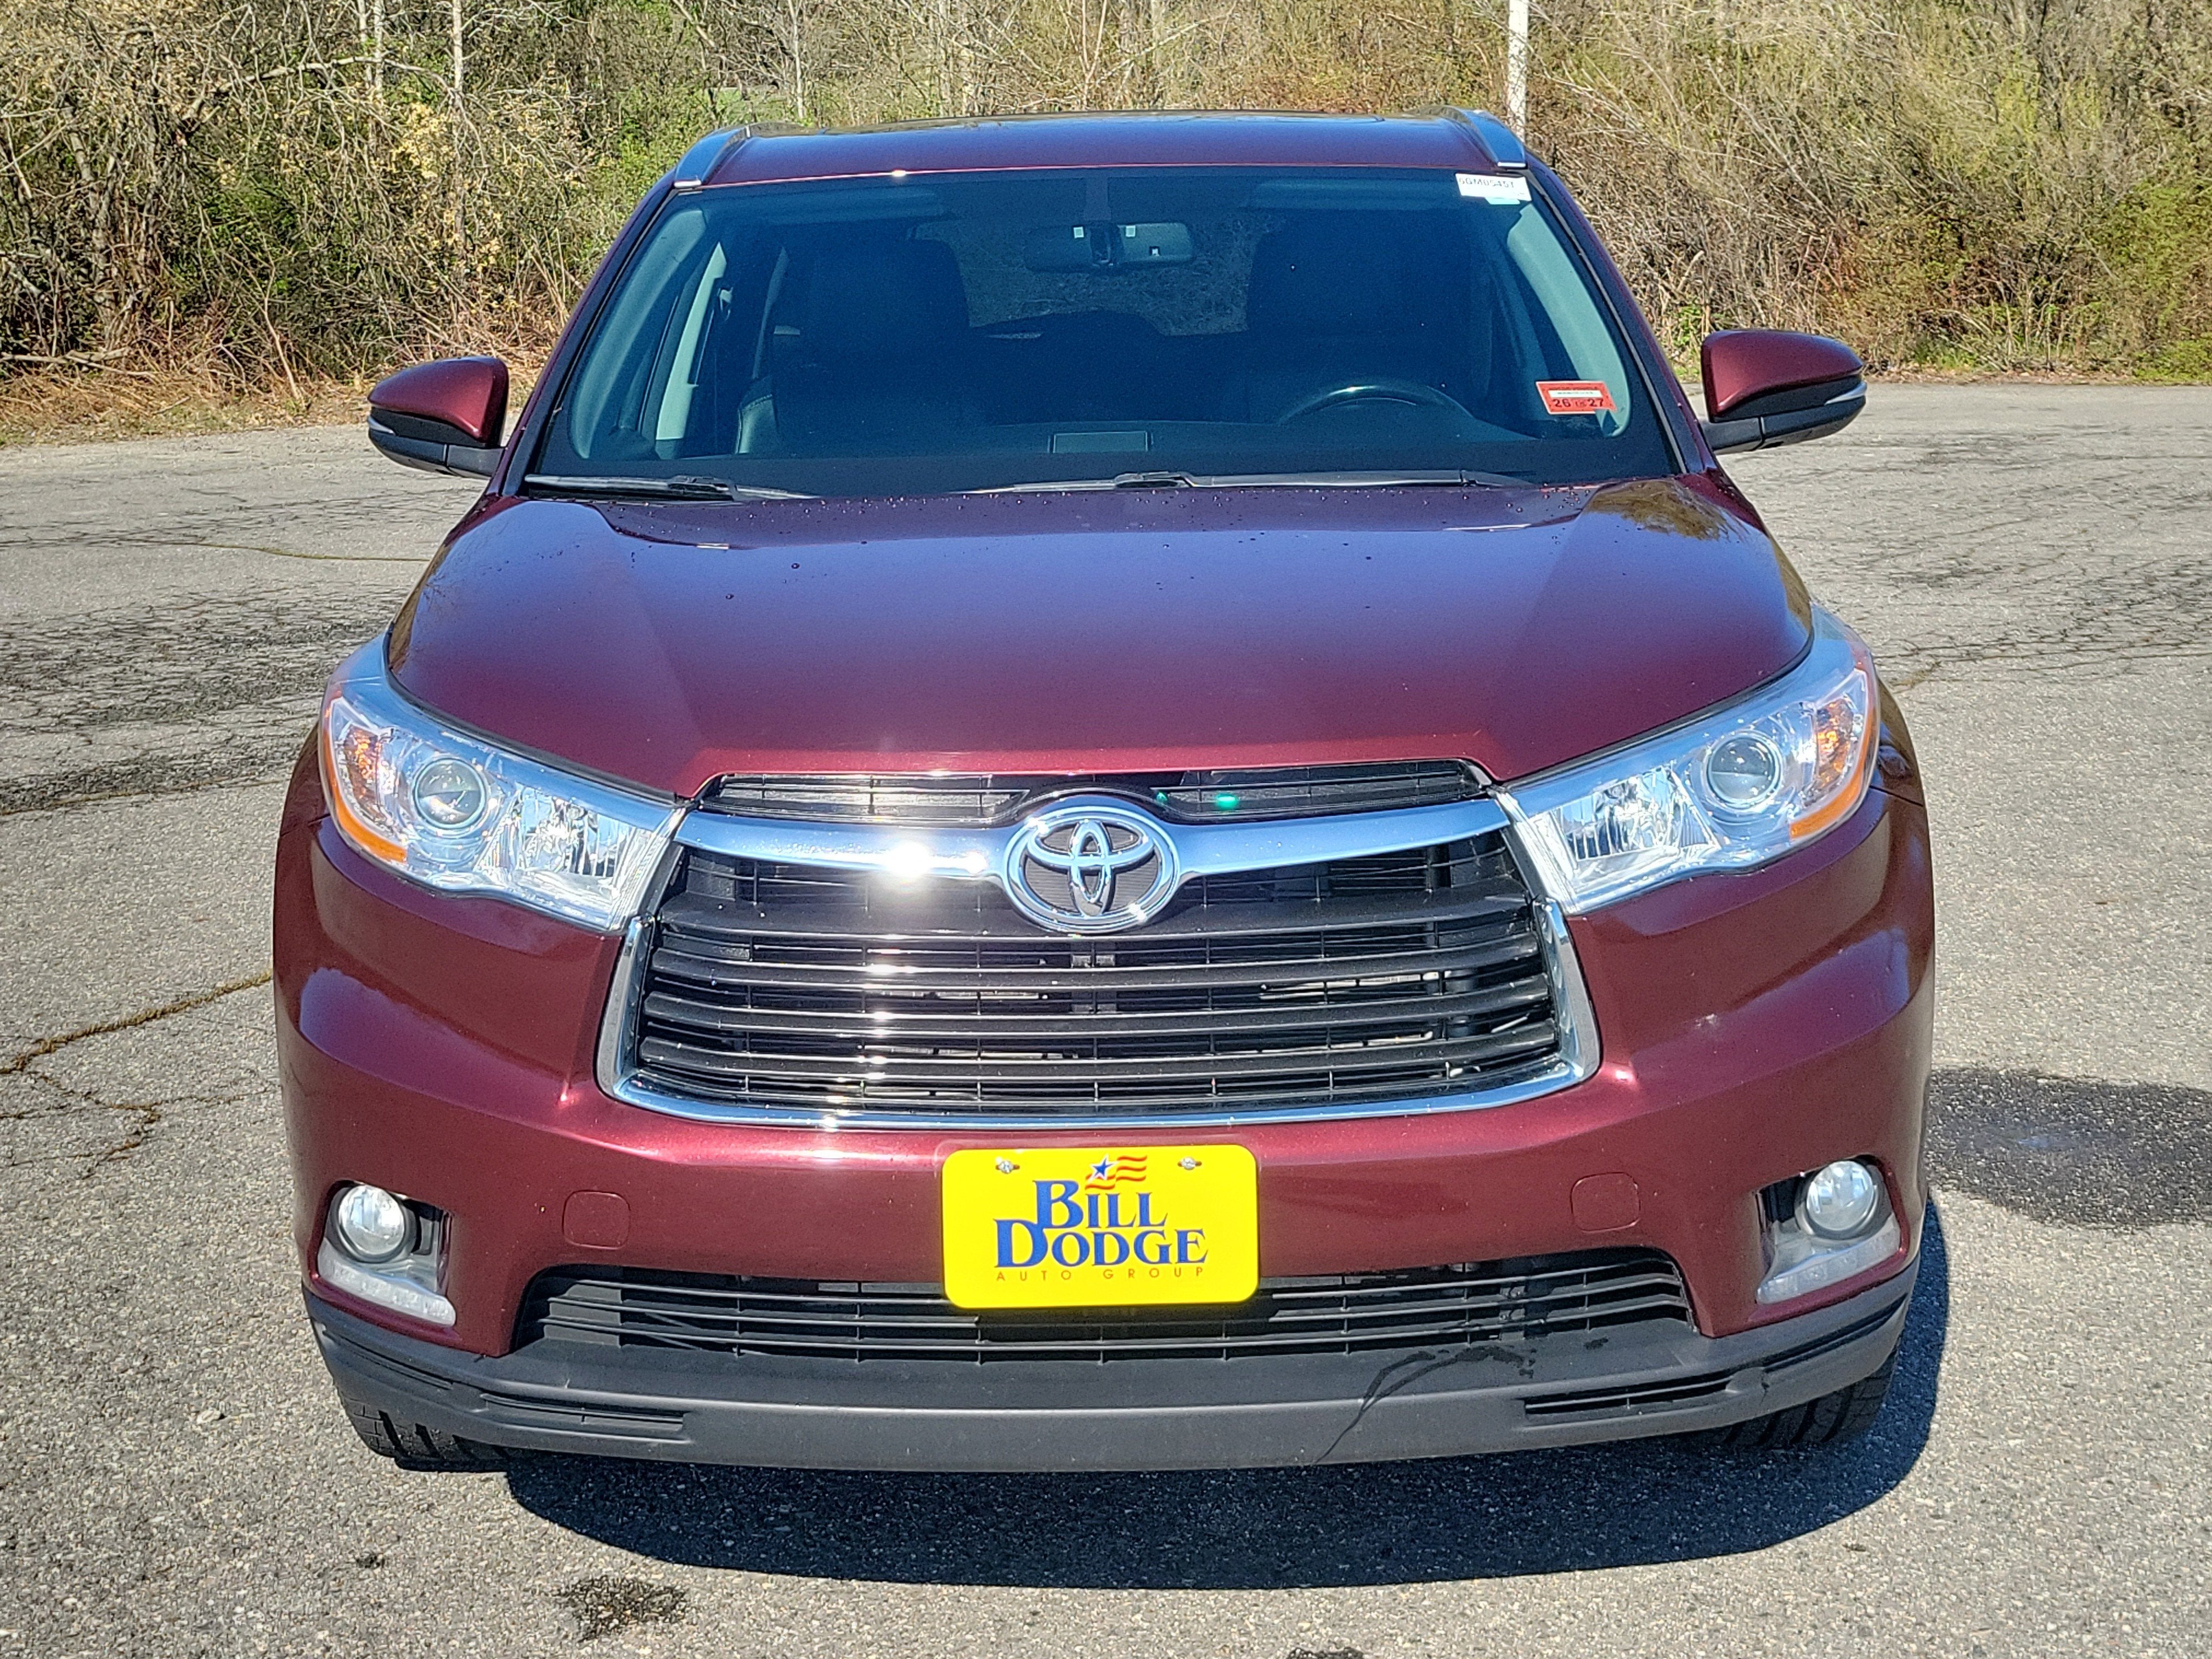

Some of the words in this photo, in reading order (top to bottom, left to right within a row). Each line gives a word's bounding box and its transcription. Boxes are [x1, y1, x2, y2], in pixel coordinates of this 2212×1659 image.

[1552, 398, 1571, 408] 26
[1587, 398, 1604, 408] 27
[1032, 1180, 1168, 1229] BILL
[993, 1218, 1209, 1268] DODGE
[996, 1269, 1073, 1282] AUTO
[1102, 1266, 1204, 1280] GROUP
